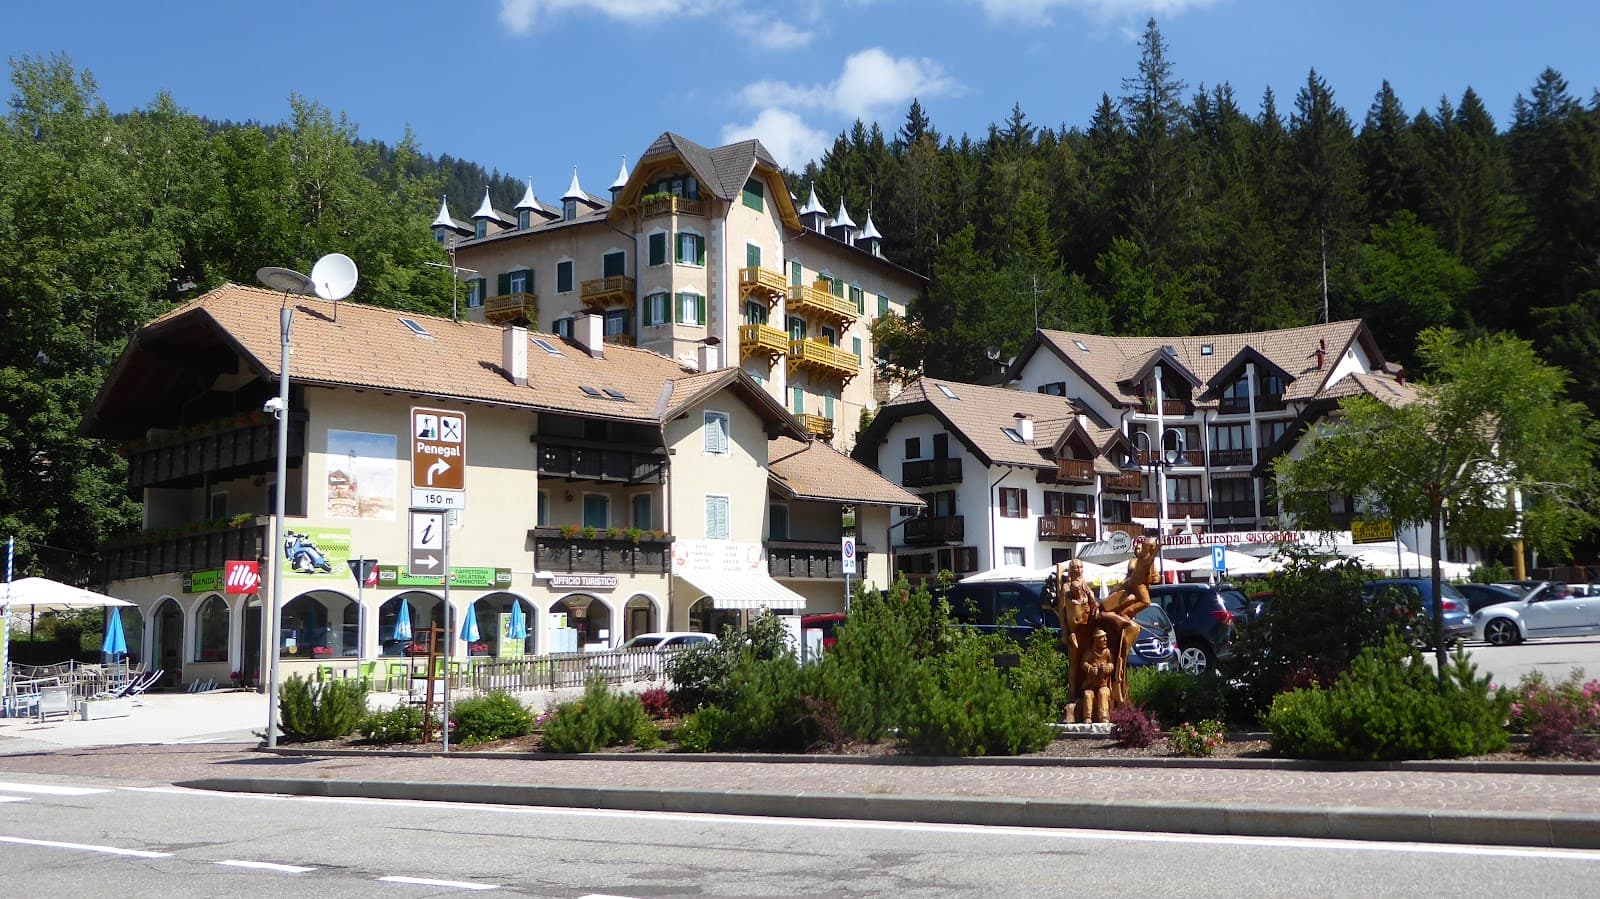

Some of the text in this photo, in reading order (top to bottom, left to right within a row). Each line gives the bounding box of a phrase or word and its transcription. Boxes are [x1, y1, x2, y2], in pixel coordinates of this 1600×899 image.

[417, 442, 461, 458] Penegal
[425, 495, 454, 505] 150 m
[1195, 532, 1240, 547] Europa
[1214, 552, 1224, 568] P
[228, 564, 257, 591] illy
[553, 576, 617, 586] UFFICIO TURISTICO
